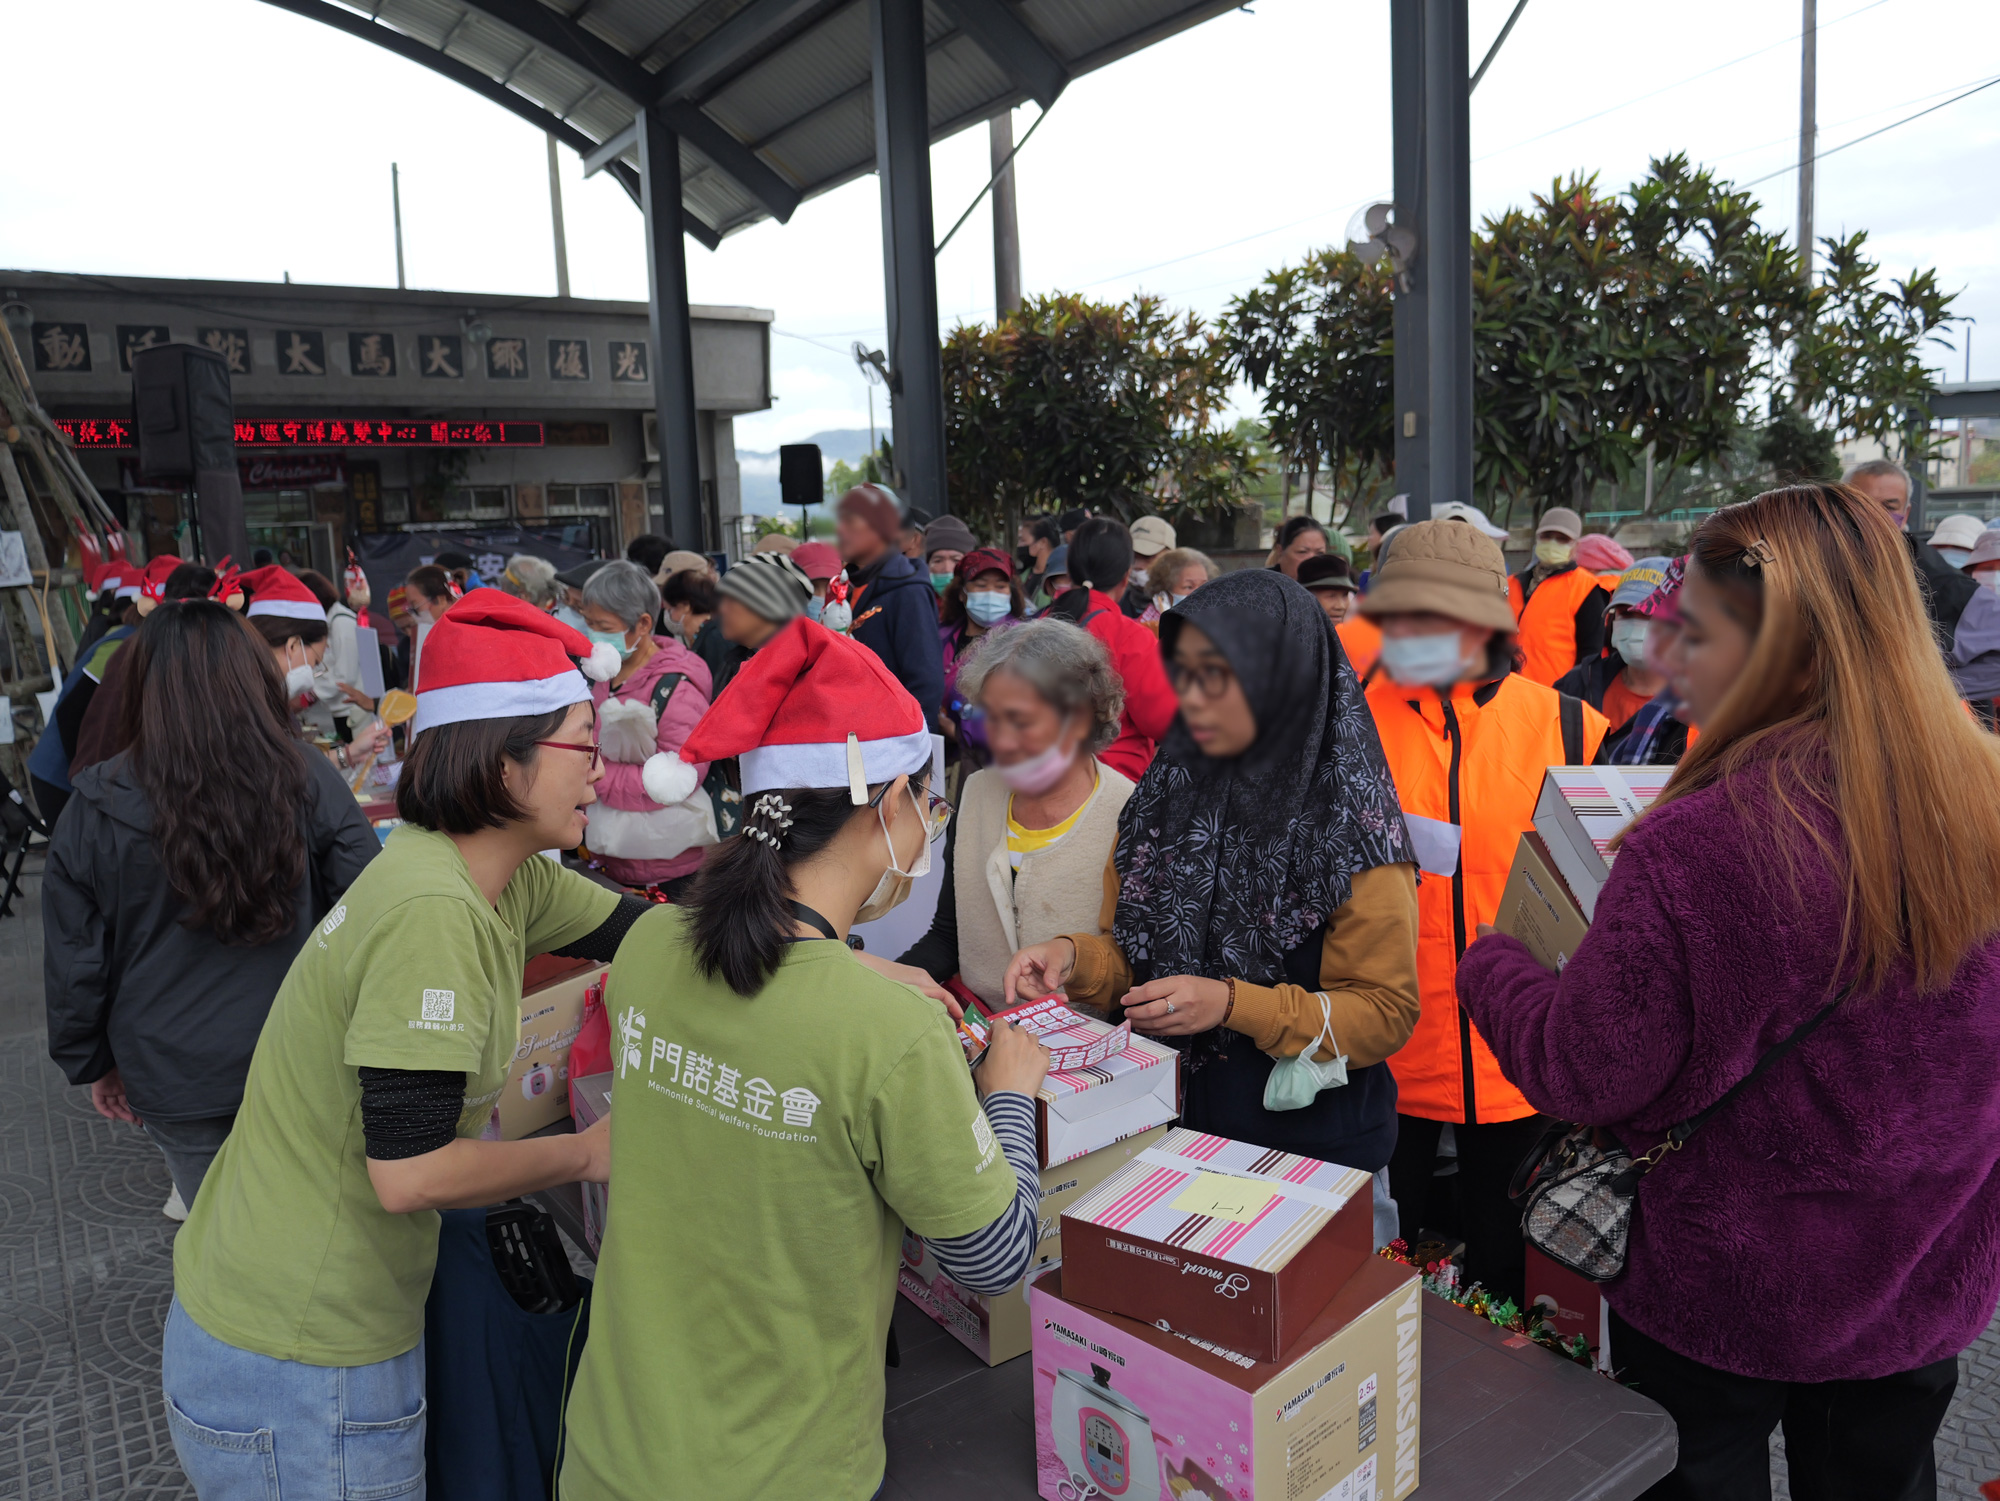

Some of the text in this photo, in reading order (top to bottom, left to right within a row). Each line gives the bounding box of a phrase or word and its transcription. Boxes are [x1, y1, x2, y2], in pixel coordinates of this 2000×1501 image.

[249, 461, 332, 485] Christmas
[516, 1029, 560, 1060] Smart
[649, 1035, 822, 1129] 門諾基金會
[647, 1079, 818, 1144] Mennonite Social Welfare Foundation
[1181, 1262, 1251, 1299] Smart
[1052, 1322, 1087, 1347] YAMASAKI
[1283, 1384, 1315, 1413] YAMASAKI
[1358, 1380, 1377, 1400] 2.5L
[1393, 1285, 1419, 1499] YAMASAKI
